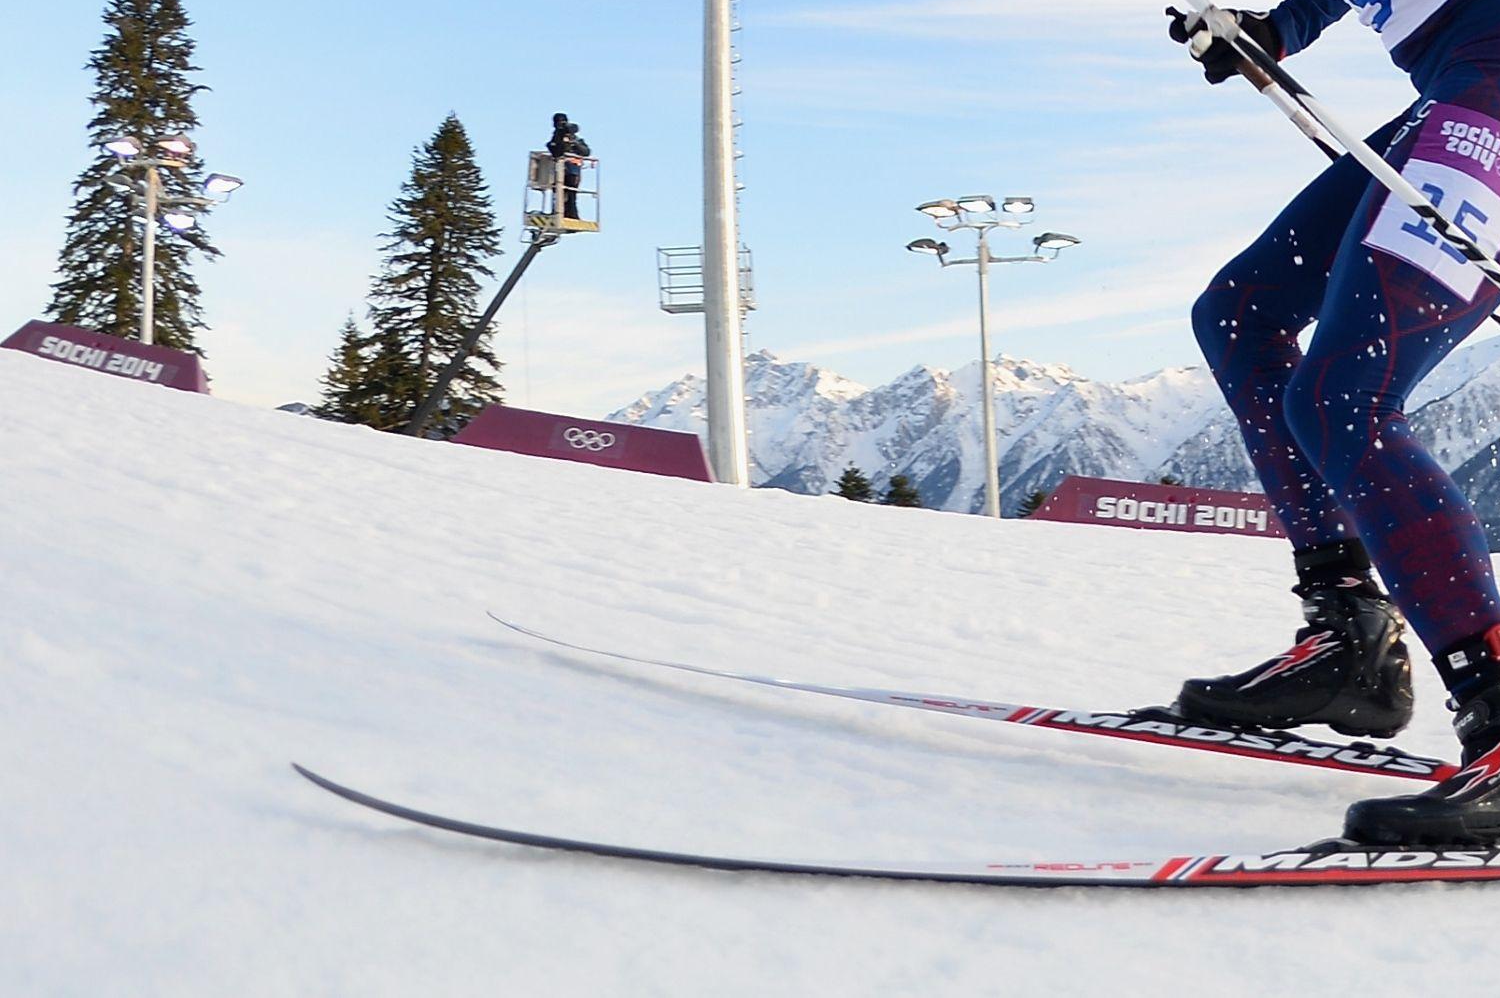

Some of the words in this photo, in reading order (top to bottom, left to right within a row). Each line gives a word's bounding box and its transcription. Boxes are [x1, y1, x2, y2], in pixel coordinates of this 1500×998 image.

[1445, 136, 1497, 172] 2014
[38, 335, 107, 369] SOCHI
[106, 353, 163, 381] 2014
[1095, 496, 1188, 525] SOCHI
[1194, 504, 1268, 532] 2014
[1053, 709, 1441, 775] MADSHUS
